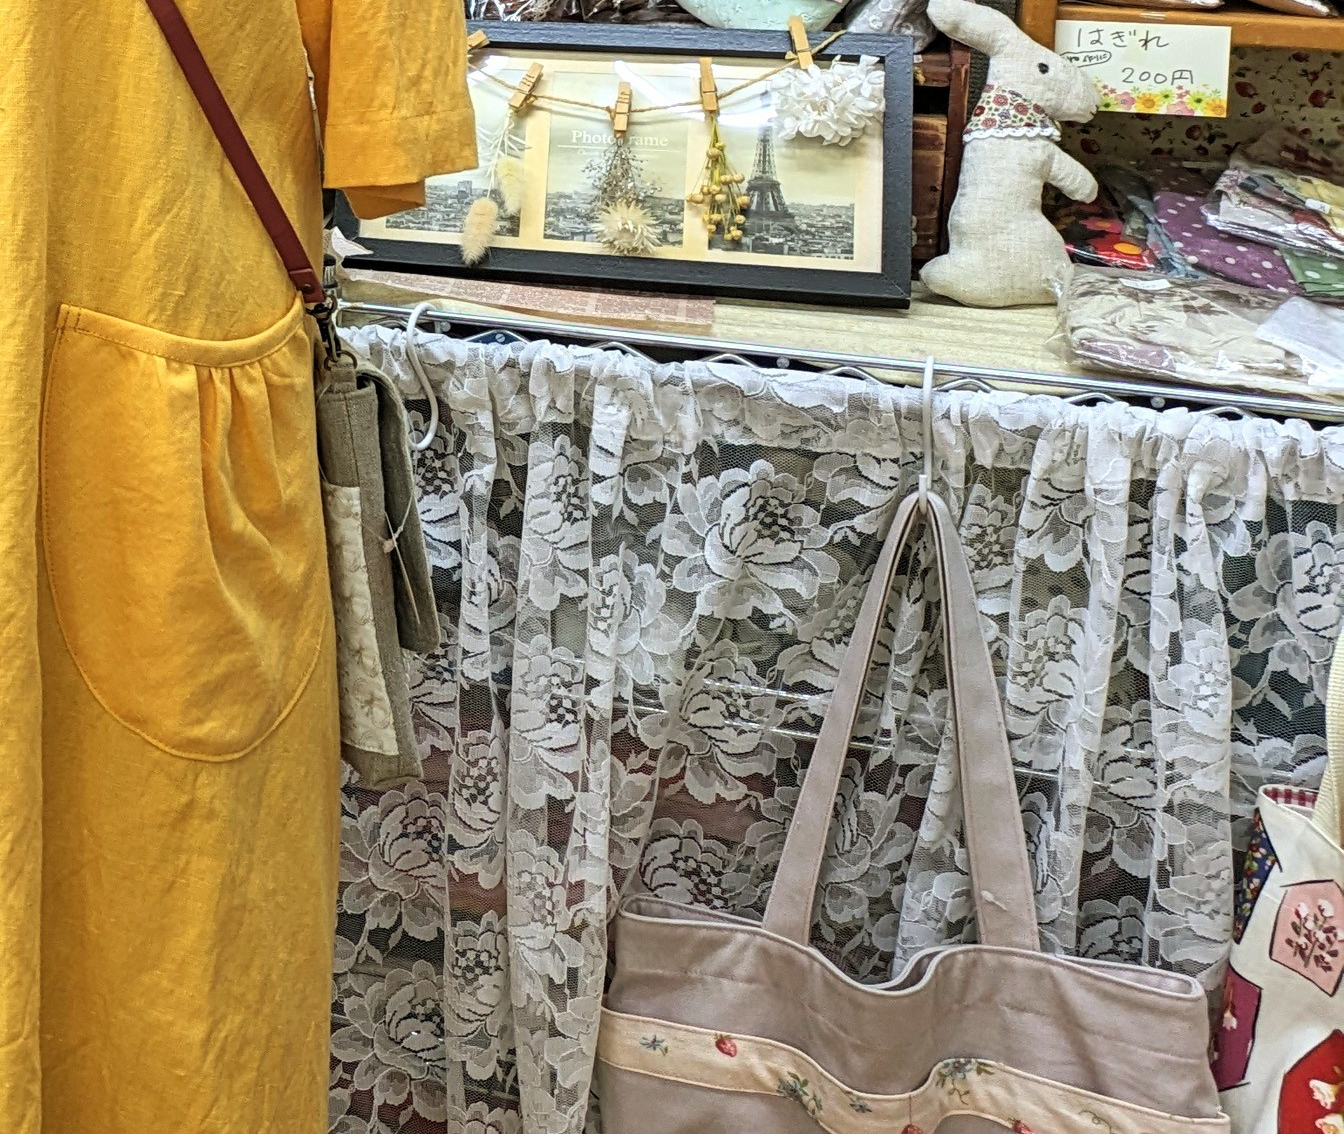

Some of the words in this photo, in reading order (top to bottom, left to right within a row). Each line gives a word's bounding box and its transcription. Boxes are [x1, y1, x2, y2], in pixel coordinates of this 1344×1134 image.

[1077, 27, 1169, 51] はぎれ
[1121, 66, 1194, 86] 200円
